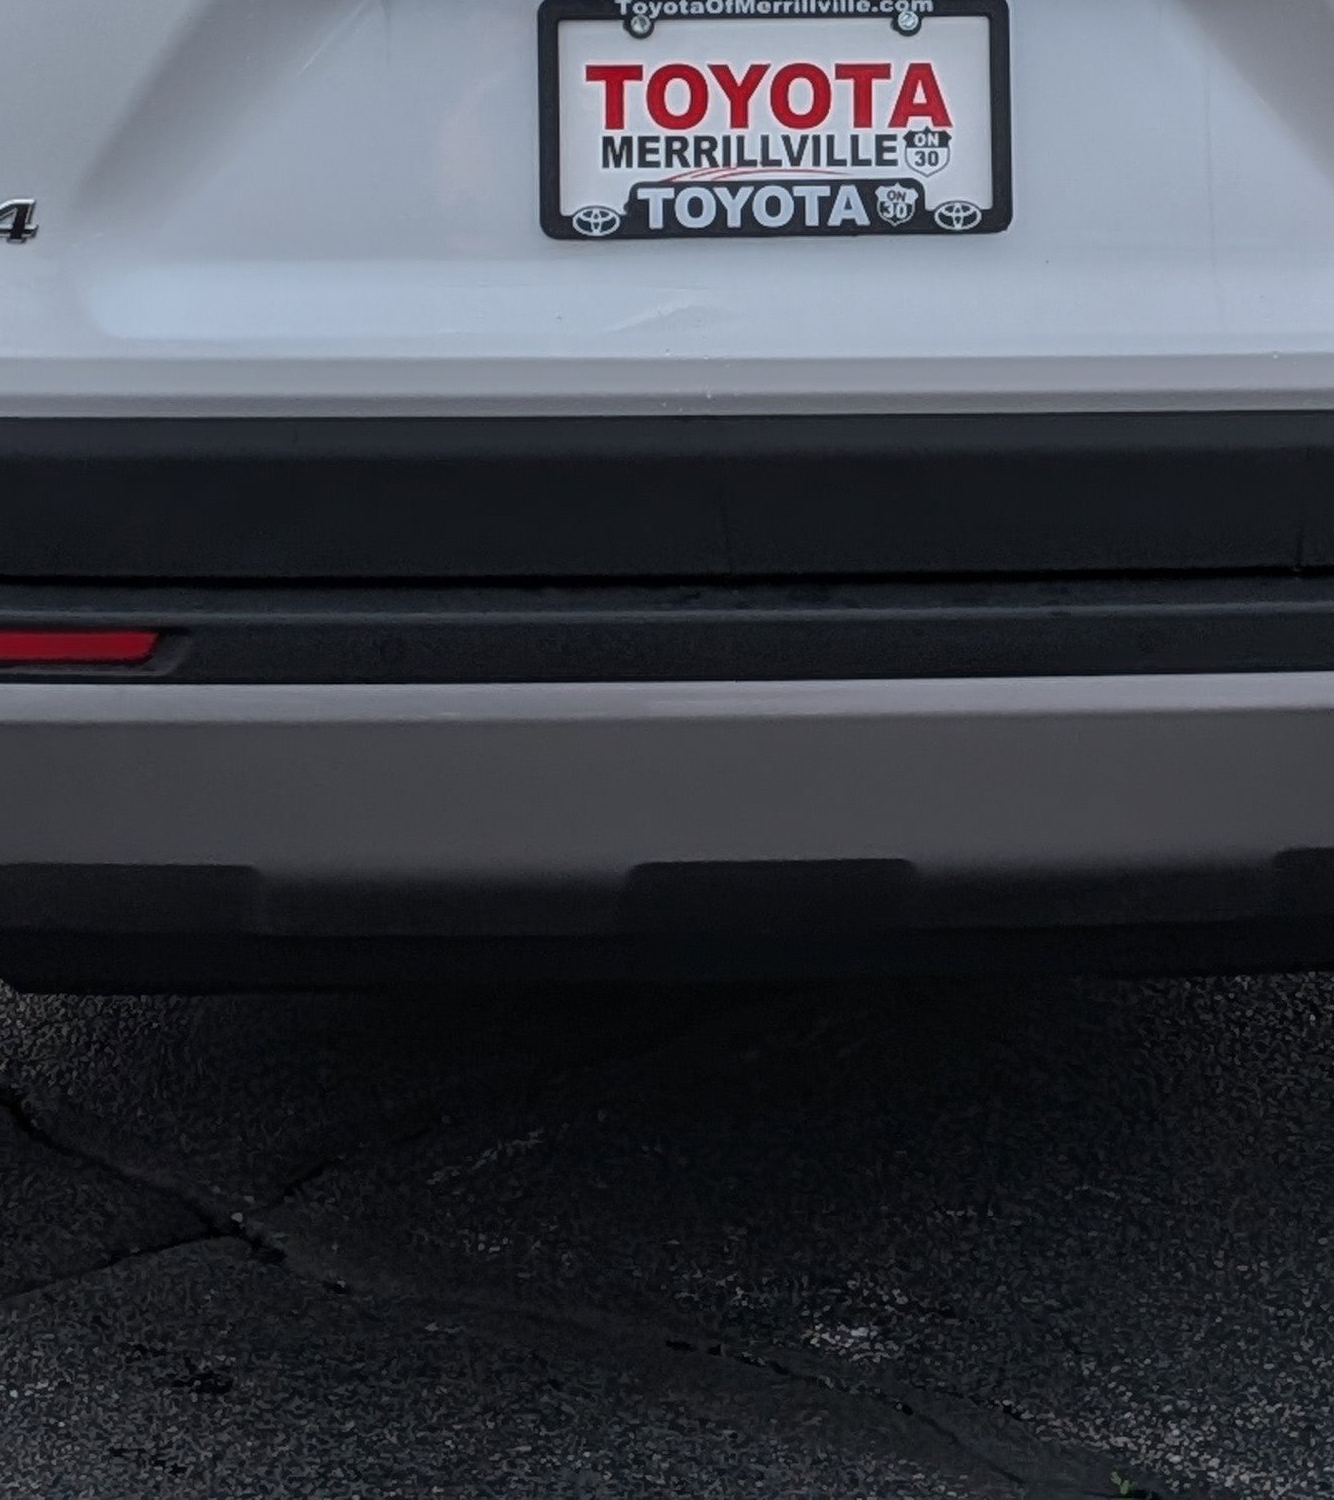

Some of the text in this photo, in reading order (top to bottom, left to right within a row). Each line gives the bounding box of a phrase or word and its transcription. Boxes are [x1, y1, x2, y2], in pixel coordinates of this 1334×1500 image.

[585, 62, 953, 130] TOYOTA
[913, 132, 940, 147] ON
[601, 133, 899, 169] MERRILLVILLE
[914, 150, 940, 167] 30
[886, 189, 907, 202] ON
[637, 184, 870, 230] TOYOTA
[882, 201, 908, 220] 30
